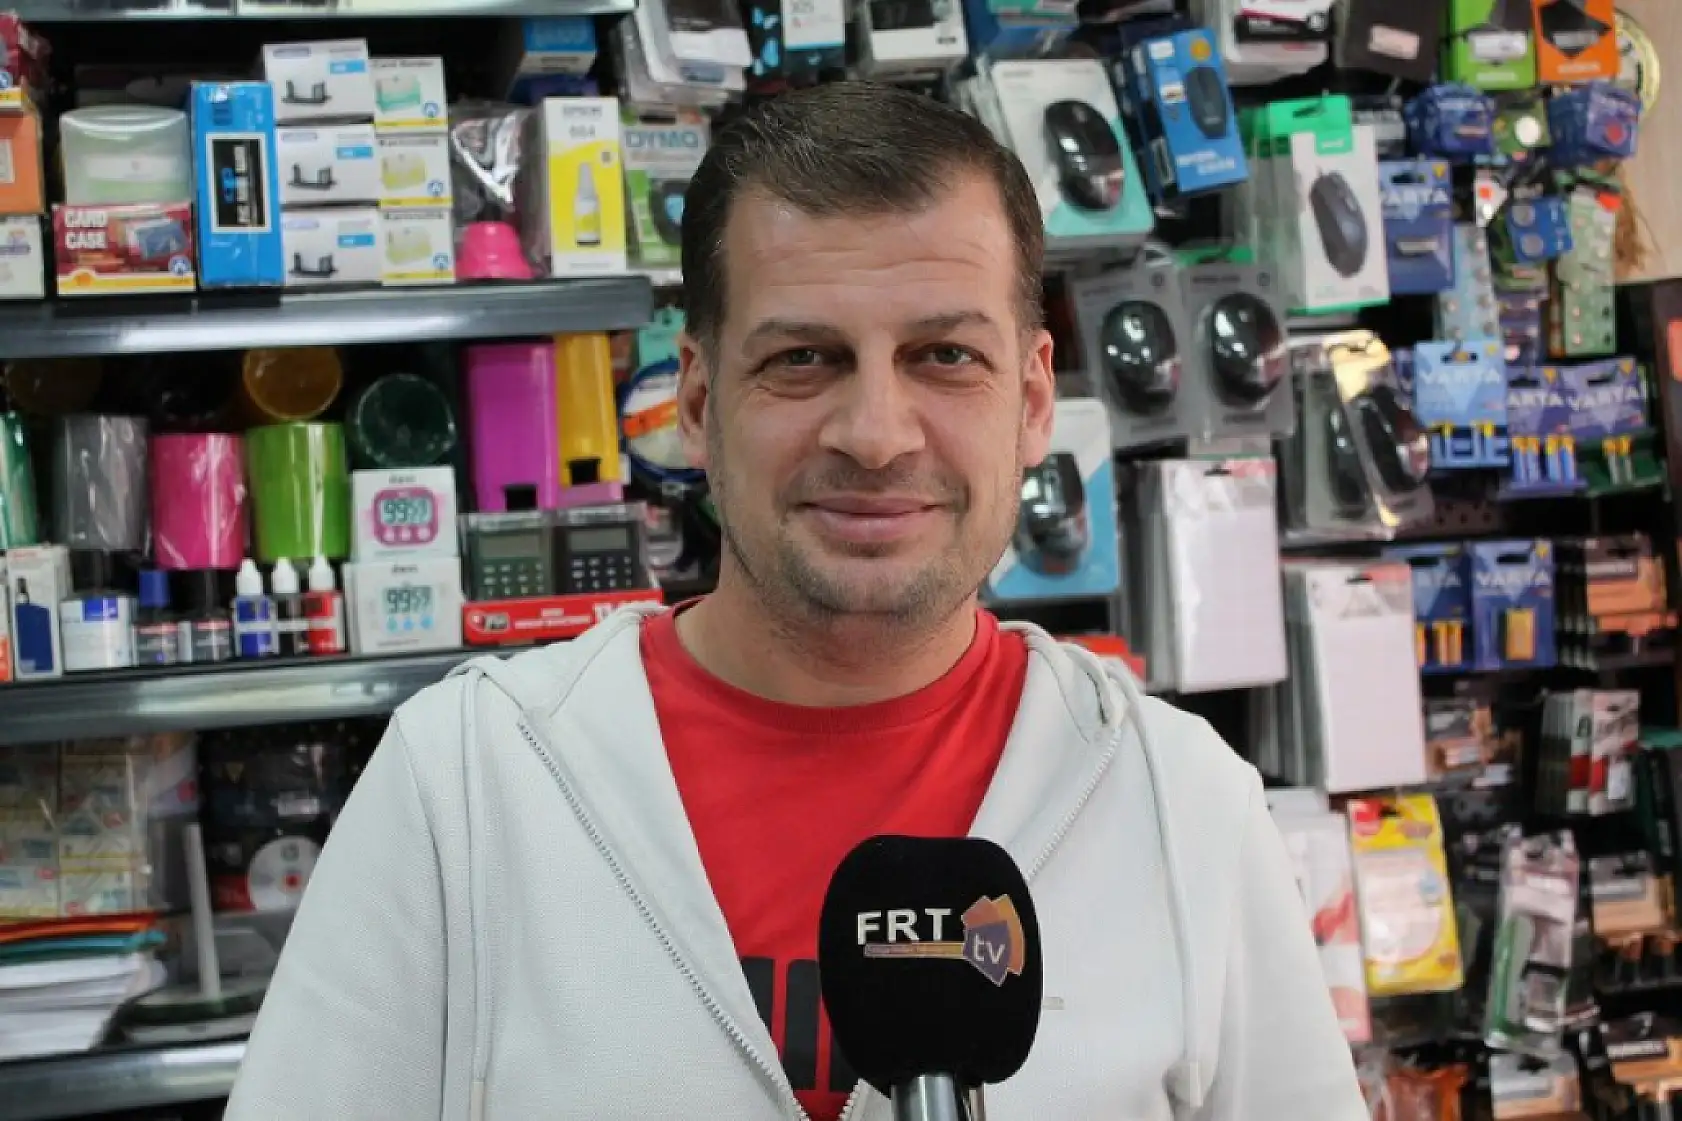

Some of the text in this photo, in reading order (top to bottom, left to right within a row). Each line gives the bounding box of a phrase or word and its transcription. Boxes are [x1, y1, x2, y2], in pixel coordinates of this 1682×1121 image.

[626, 131, 699, 148] DYMO
[65, 210, 107, 227] CARD
[65, 232, 106, 249] CASE
[1418, 369, 1501, 385] VARTA
[1507, 390, 1563, 407] ARTA
[1568, 385, 1641, 412] VARTA
[1475, 569, 1551, 588] VARTA
[857, 908, 1006, 964] FRT tv
